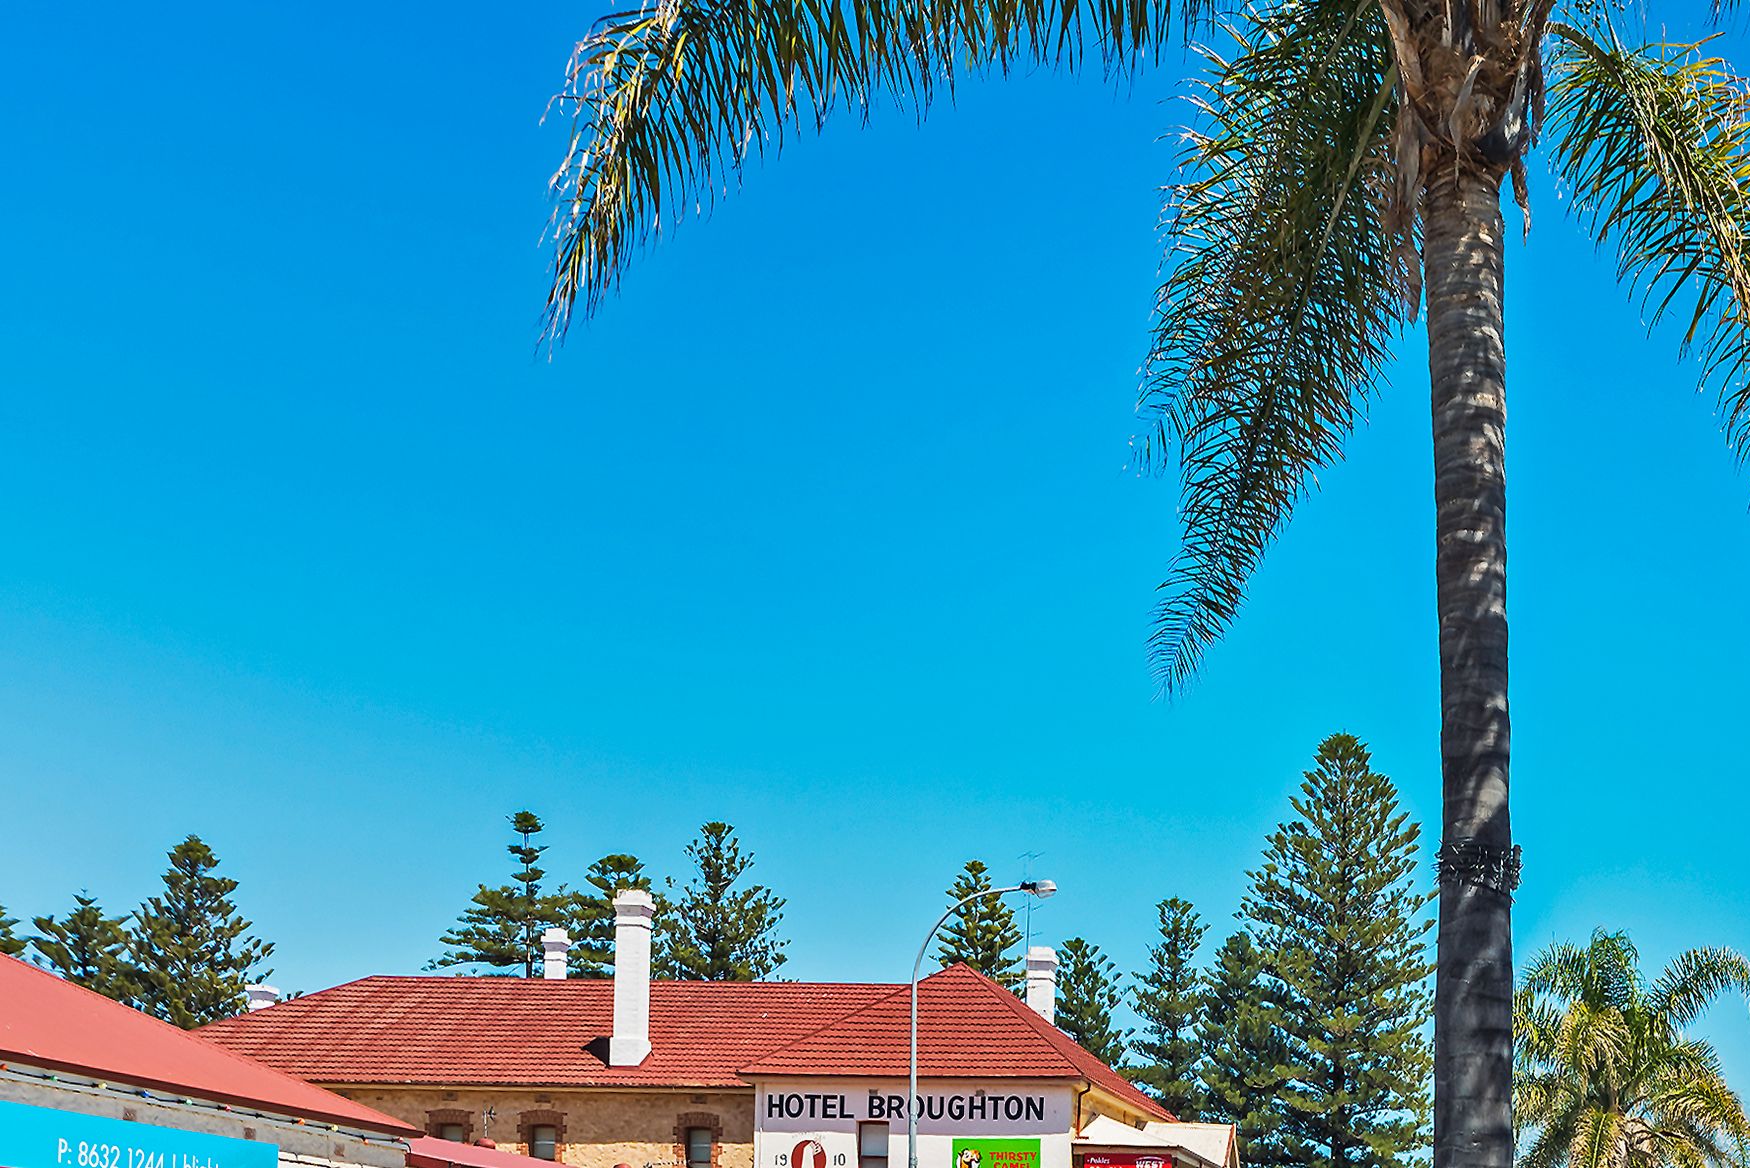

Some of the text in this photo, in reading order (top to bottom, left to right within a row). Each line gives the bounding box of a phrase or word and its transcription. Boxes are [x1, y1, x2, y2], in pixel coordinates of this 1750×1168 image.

[767, 1094, 1045, 1121] HOTEL BROUGHTON
[57, 1138, 72, 1165] P:
[990, 1151, 1037, 1162] THIRSTY
[774, 1154, 846, 1167] 19 10
[1135, 1160, 1164, 1168] WEST
